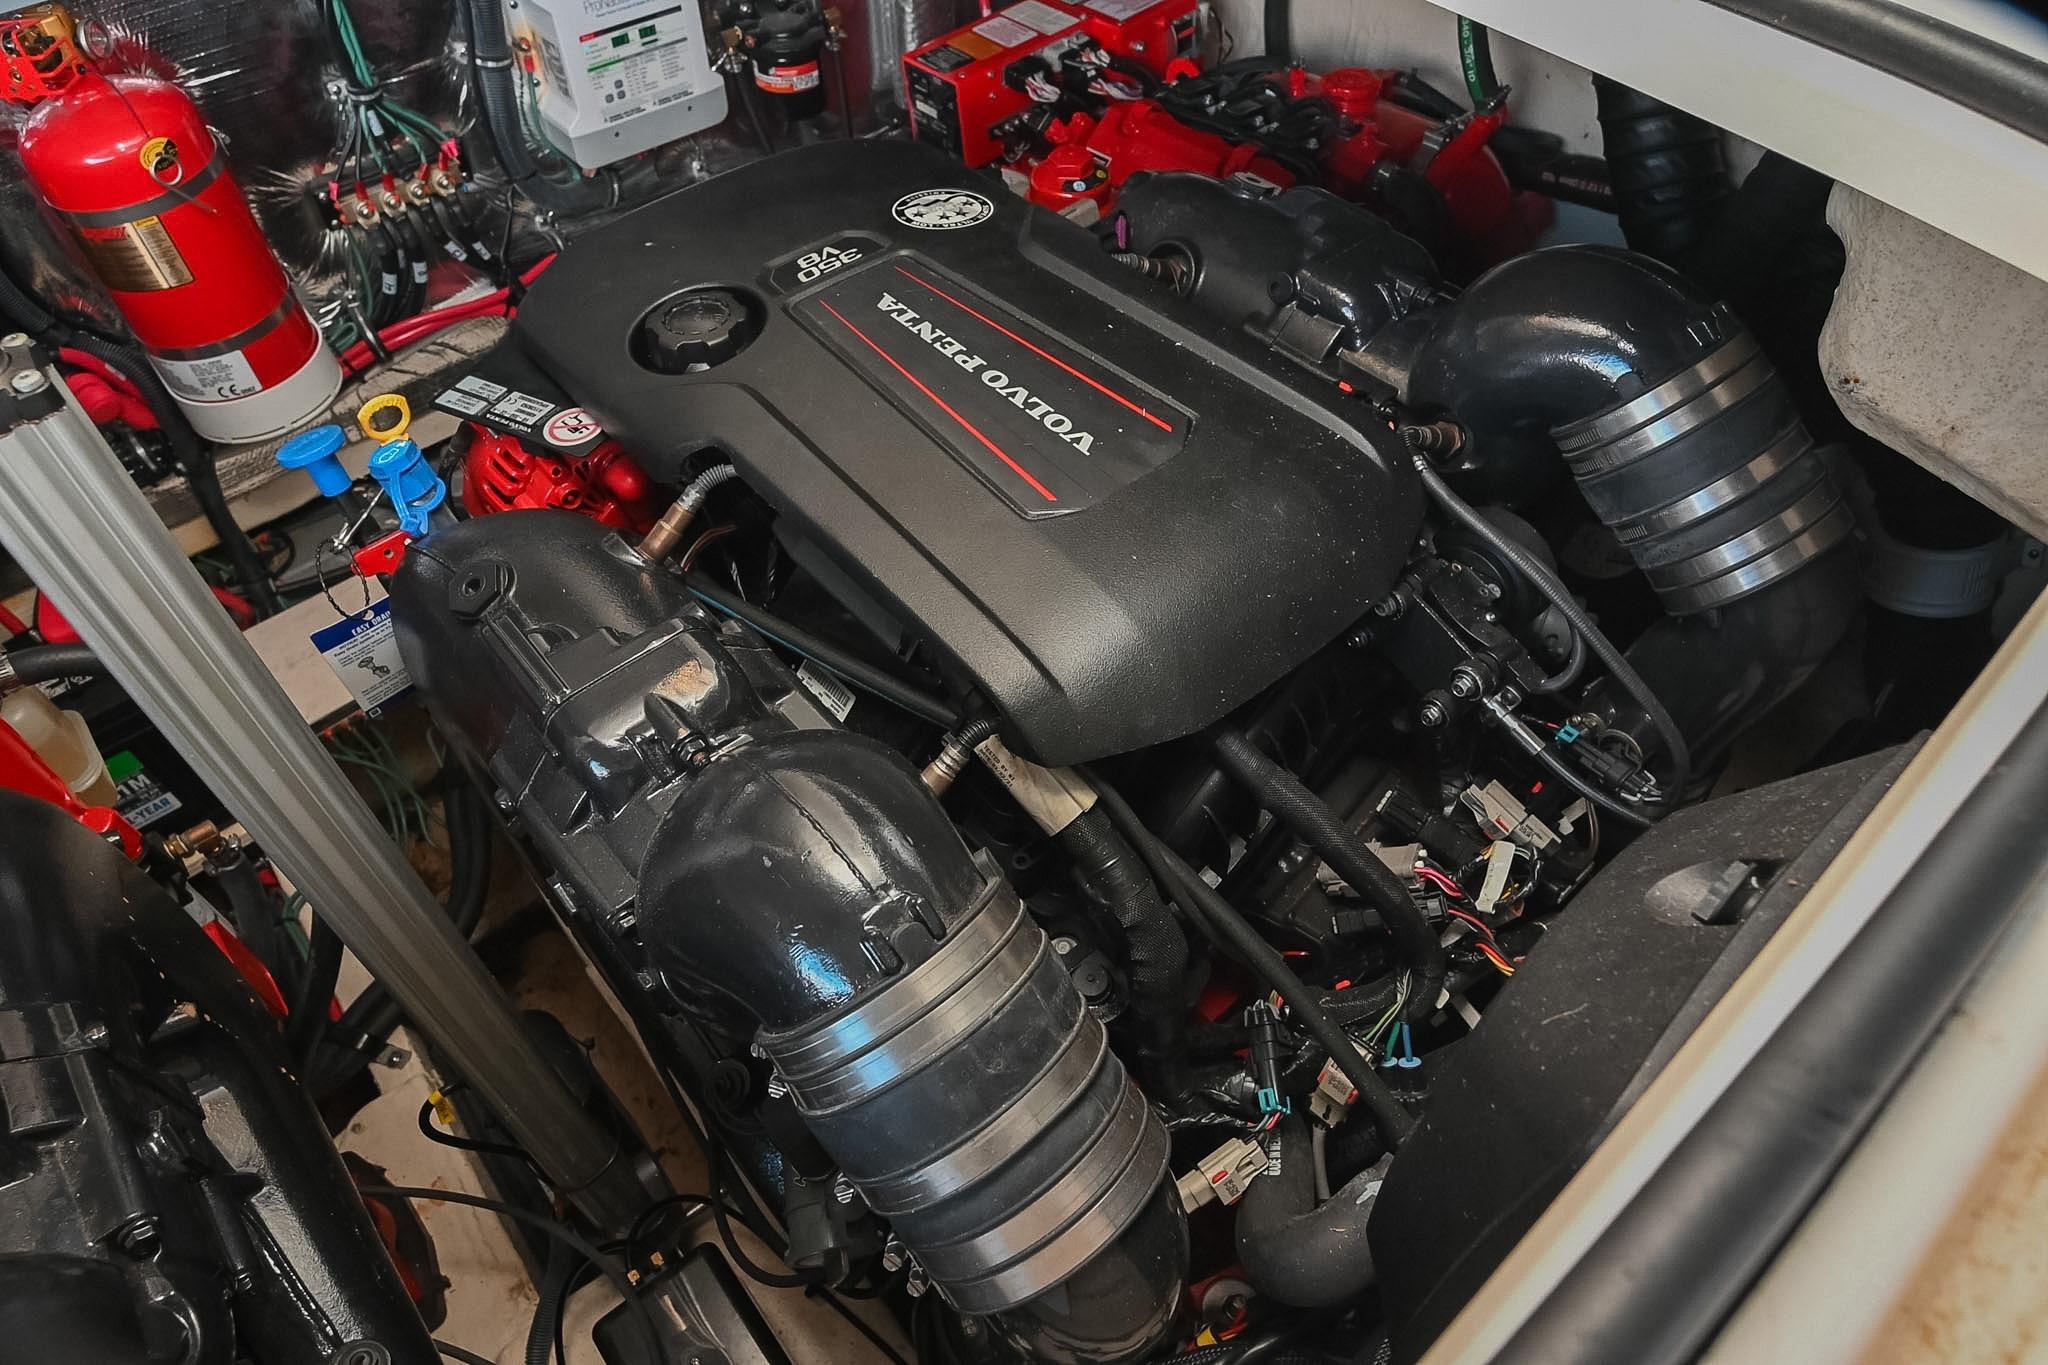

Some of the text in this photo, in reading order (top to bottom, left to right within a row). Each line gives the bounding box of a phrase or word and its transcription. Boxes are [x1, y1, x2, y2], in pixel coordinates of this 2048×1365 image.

[910, 220, 933, 228] LOW
[943, 218, 974, 228] ULTRA
[797, 246, 841, 269] V8
[797, 248, 863, 283] 350
[876, 292, 1095, 456] VOLVO PENTA
[351, 622, 371, 636] EASY
